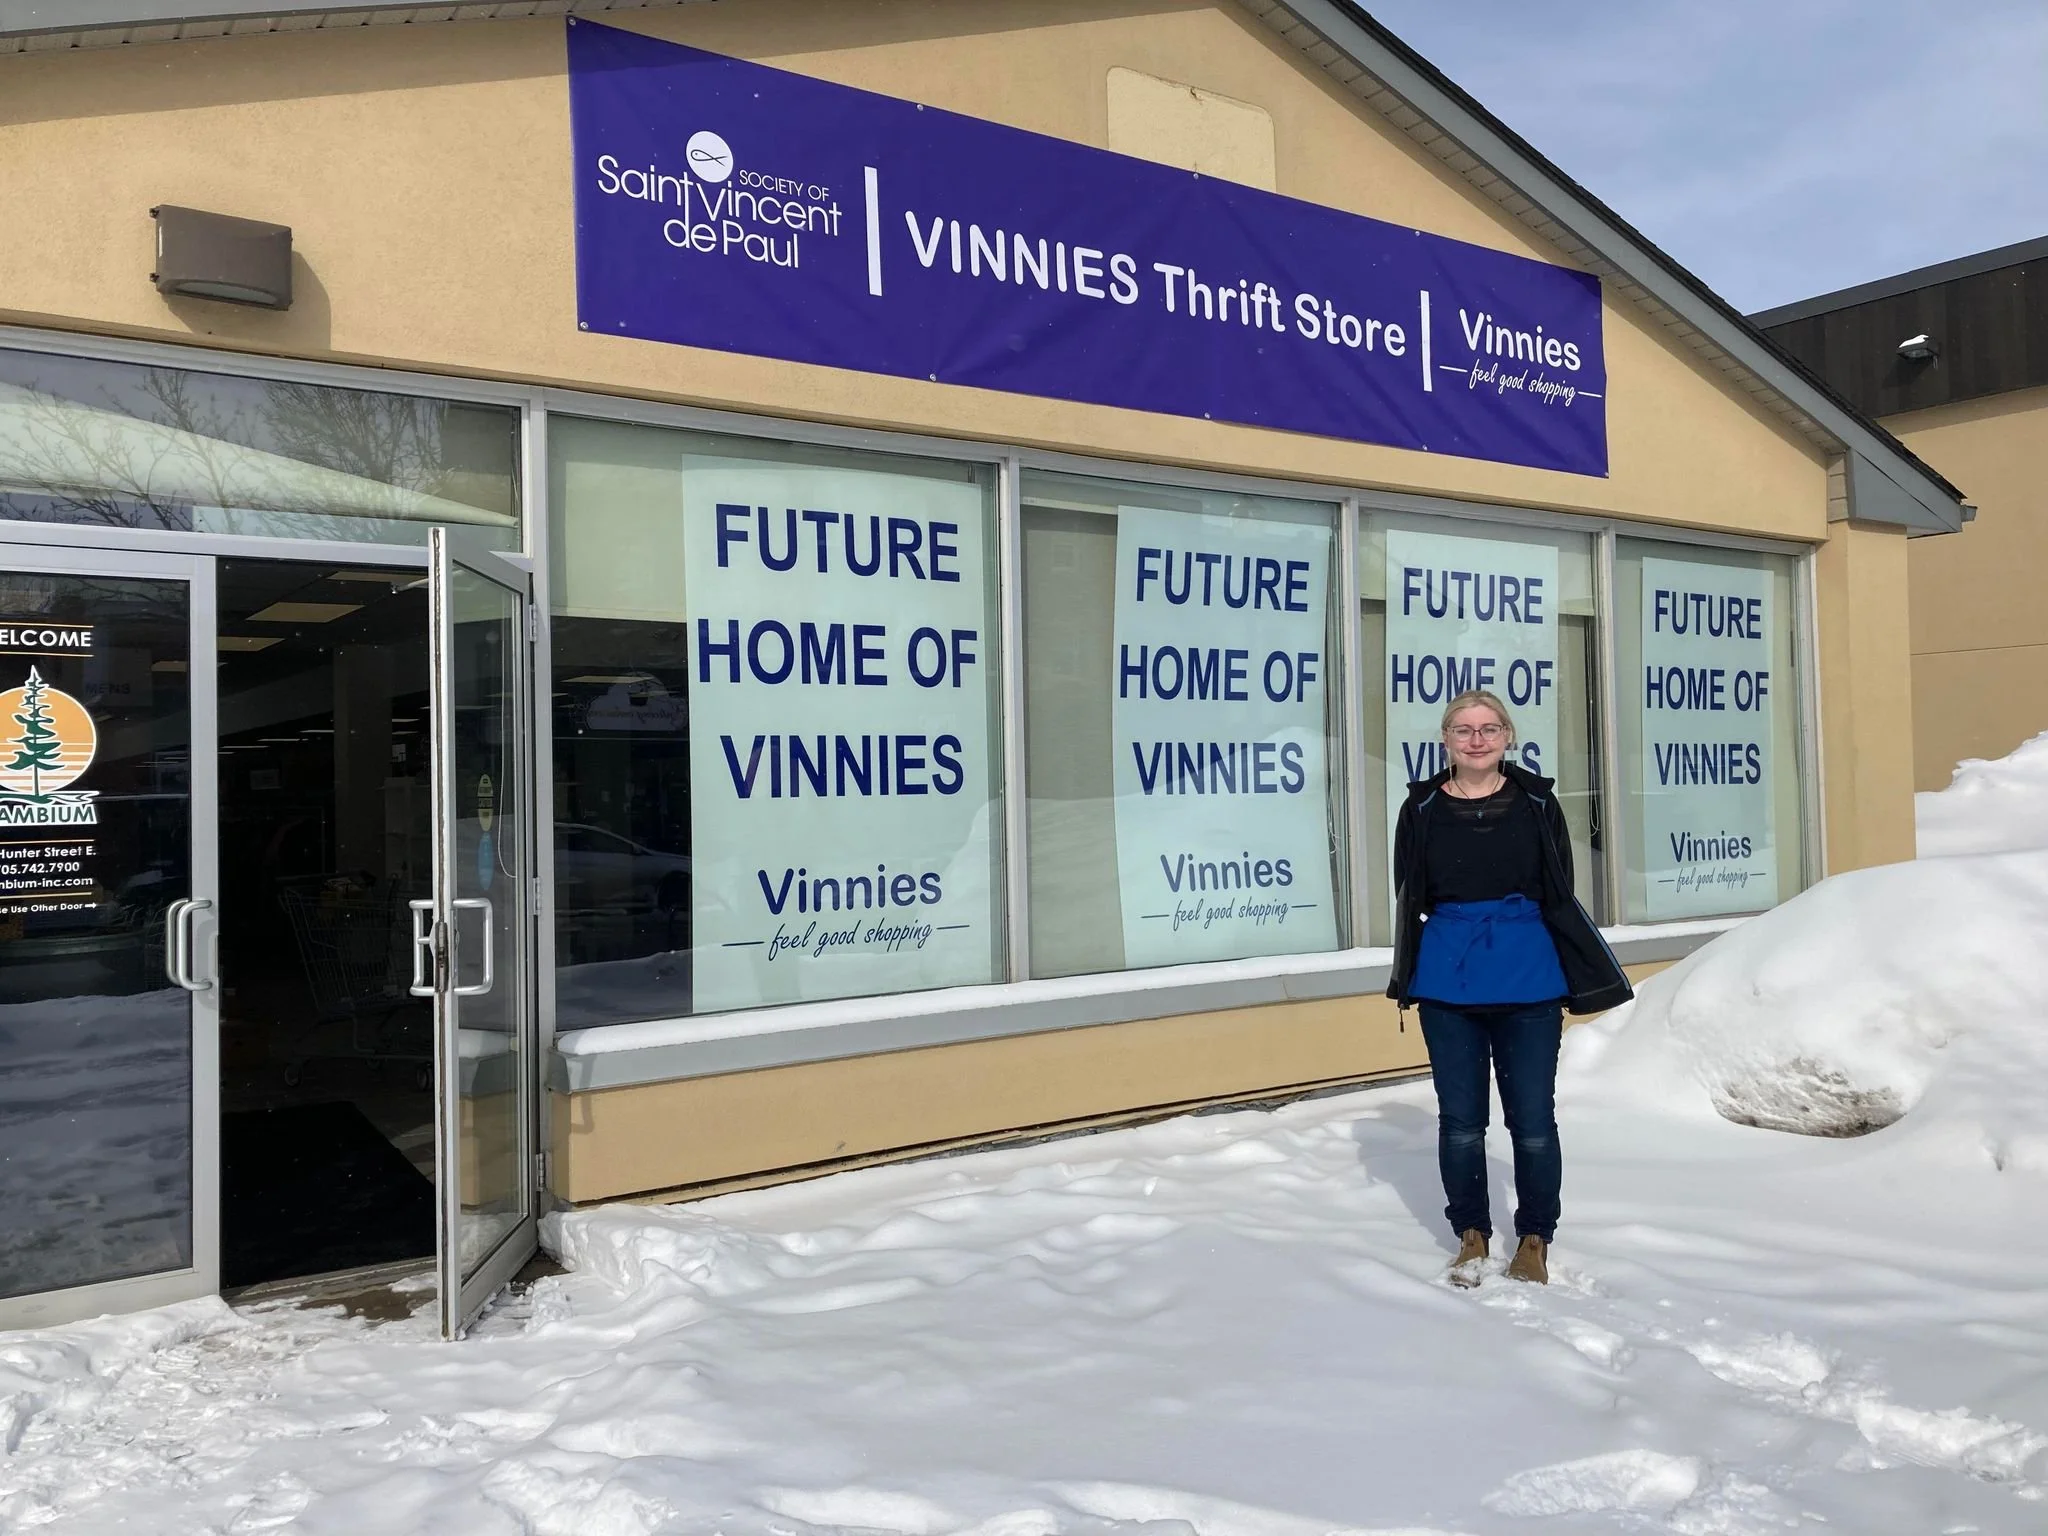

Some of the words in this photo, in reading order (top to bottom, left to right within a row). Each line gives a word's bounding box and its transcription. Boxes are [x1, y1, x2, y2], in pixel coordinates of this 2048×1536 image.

[597, 154, 694, 208] Saint
[696, 181, 843, 236] Vincent
[739, 169, 803, 197] SOCIETY
[807, 185, 829, 201] OF
[663, 217, 717, 253] de
[722, 219, 799, 268] Paul
[905, 210, 1139, 304] VINNIES
[1153, 262, 1286, 333] Thrift
[1295, 293, 1407, 356] Store
[1459, 308, 1581, 371] Vinnies
[1469, 358, 1500, 389] feel
[1499, 369, 1529, 394] good
[1528, 372, 1576, 407] shopping
[715, 503, 961, 583] FUTURE
[1136, 546, 1310, 613] FUTURE
[1403, 567, 1543, 624] FUTURE
[1654, 589, 1762, 640] FUTURE
[697, 618, 888, 687] HOME
[906, 626, 978, 689] OF
[1119, 644, 1249, 701] HOME
[1263, 650, 1319, 704] OF
[1507, 658, 1553, 706] OF
[1646, 665, 1726, 711] HOME
[1733, 670, 1769, 712] OF
[719, 733, 965, 800] VINNIES
[1132, 741, 1305, 796] VINNIES
[1654, 742, 1762, 786] VINNIES
[0, 861, 80, 875] 05.742.7900
[44, 846, 82, 858] Street
[86, 846, 97, 856] E.
[1670, 830, 1752, 863] Vinnies
[757, 863, 943, 916] Vinnies
[1160, 851, 1294, 893] Vinnies
[1676, 867, 1697, 893] feel
[1697, 866, 1715, 892] good
[1716, 866, 1748, 890] shopping
[11, 905, 28, 913] Use
[31, 903, 58, 912] Other
[60, 903, 83, 911] Door
[1173, 898, 1204, 932] feel
[1206, 897, 1235, 930] good
[1238, 895, 1289, 926] shopping
[768, 921, 817, 962] feel
[818, 919, 862, 959] good
[863, 917, 933, 953] shopping
